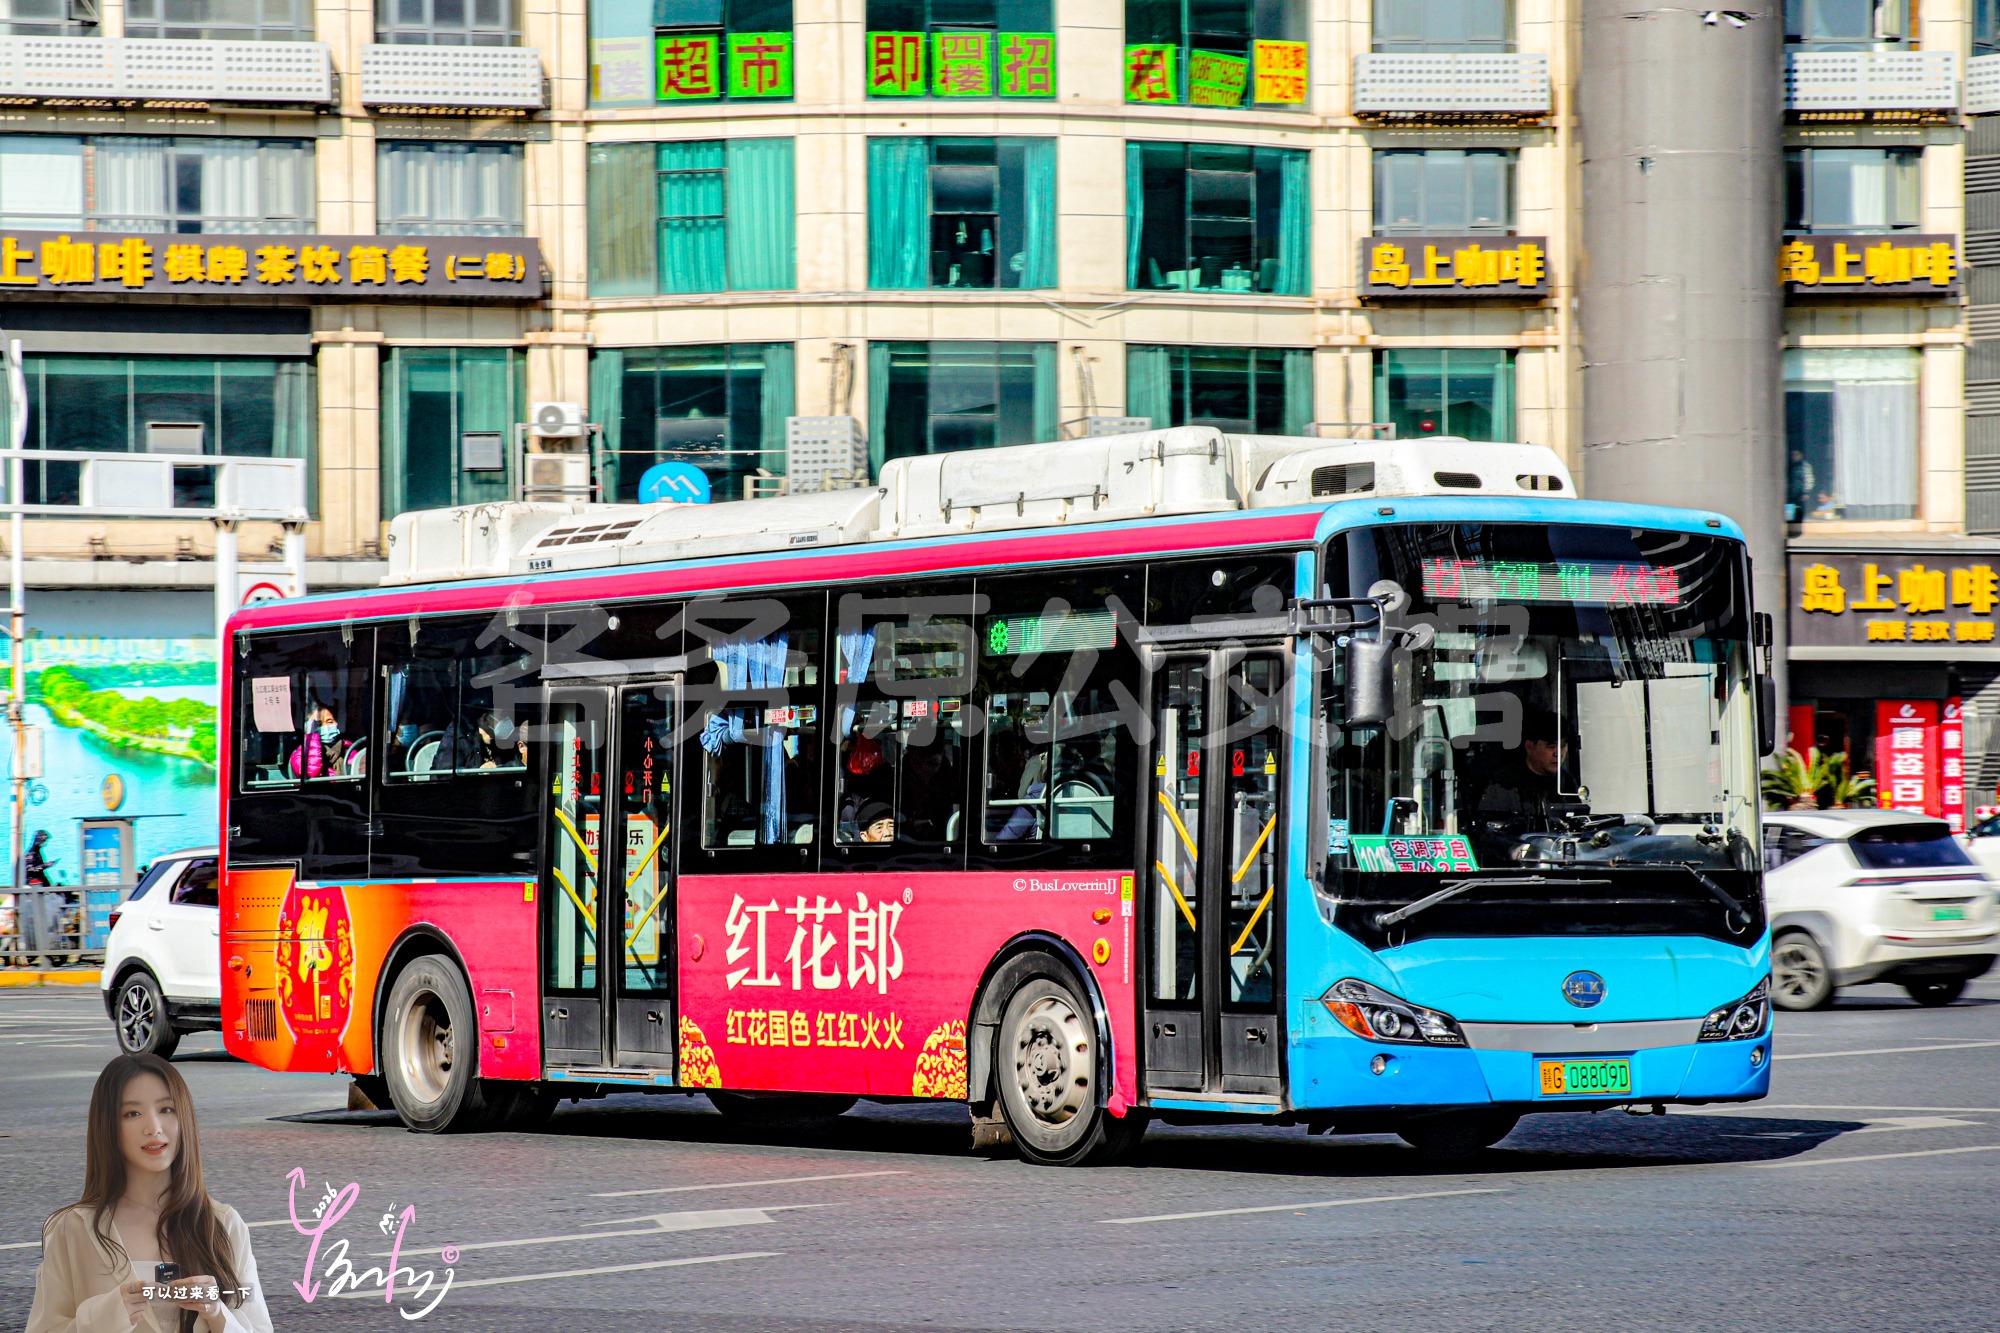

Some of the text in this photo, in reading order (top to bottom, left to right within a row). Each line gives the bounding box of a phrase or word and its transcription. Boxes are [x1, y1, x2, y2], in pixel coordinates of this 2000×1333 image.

[873, 36, 1050, 92] 即 四楼 招
[0, 235, 154, 287] 上咖啡
[163, 244, 249, 284] 棋牌
[255, 244, 342, 284] 茶饮
[348, 244, 430, 284] 简餐
[1369, 243, 1546, 288] 岛上咖啡
[1779, 241, 1958, 286] 岛上咖啡
[1491, 562, 1539, 600] 空调
[1557, 565, 1591, 599] 101
[1609, 565, 1680, 604] 火车站
[1802, 563, 1999, 614] 岛上咖啡
[1891, 727, 1925, 815] 康姿百
[1392, 839, 1469, 858] 空调开启
[725, 891, 904, 995] 红花郎
[726, 1008, 905, 1050] 红花国色 红红火火
